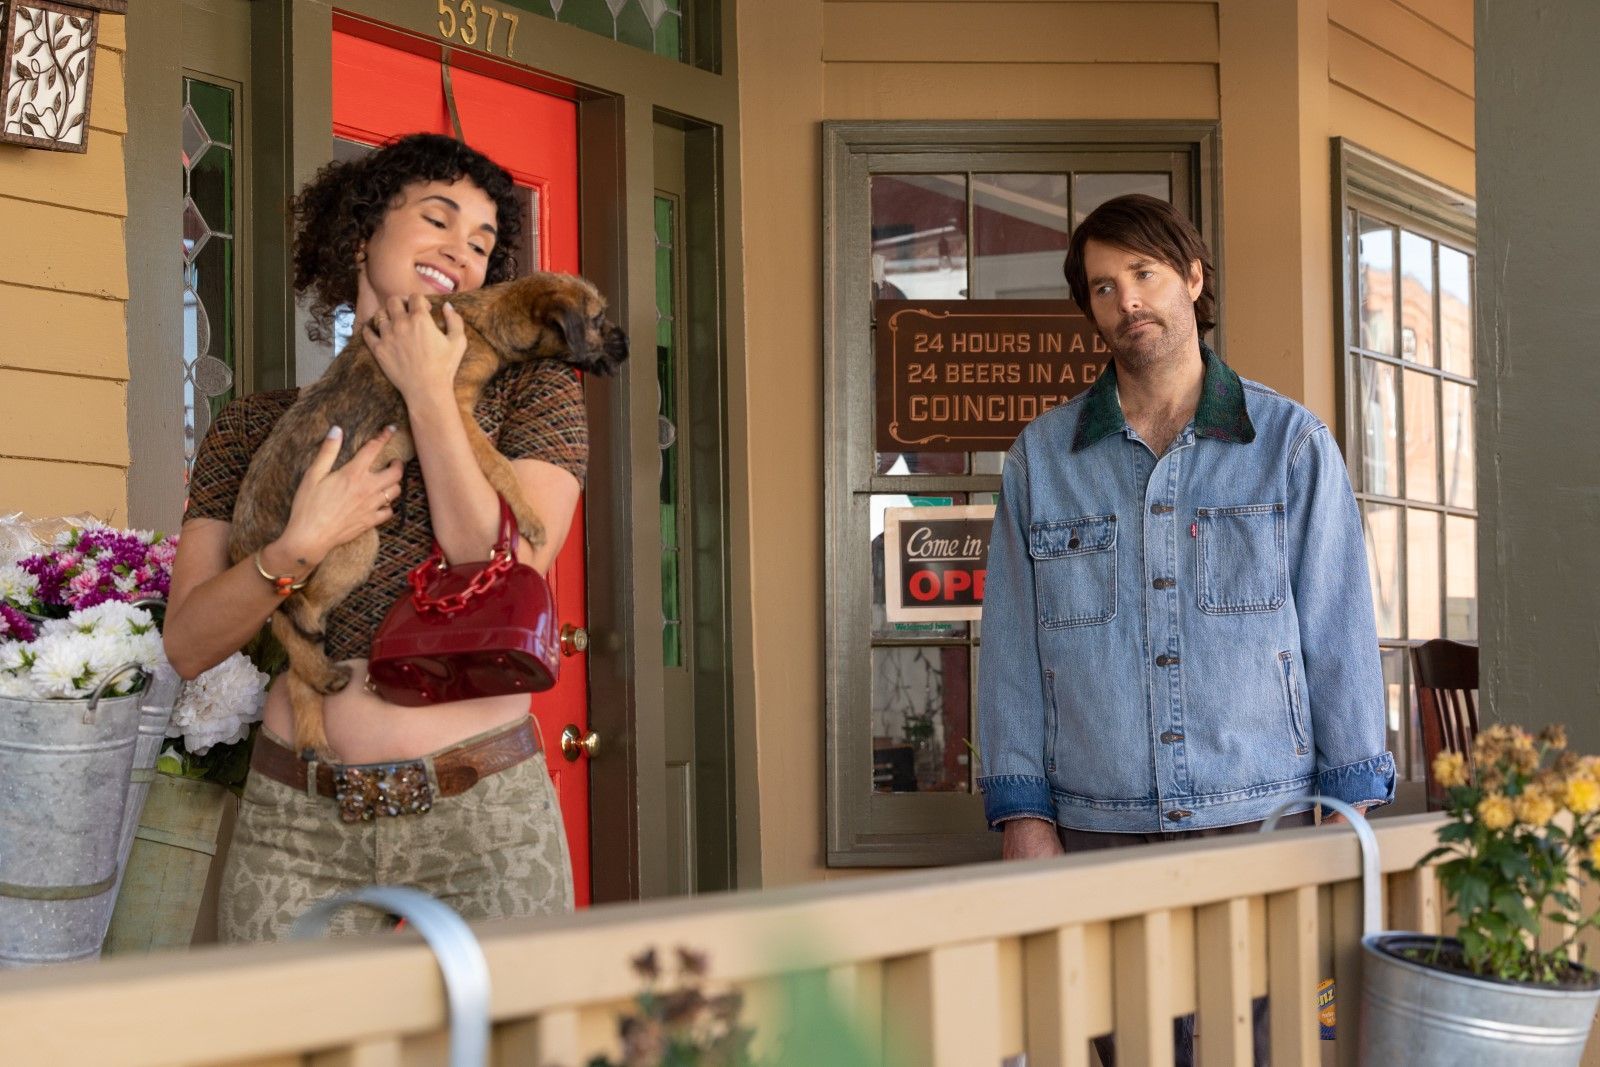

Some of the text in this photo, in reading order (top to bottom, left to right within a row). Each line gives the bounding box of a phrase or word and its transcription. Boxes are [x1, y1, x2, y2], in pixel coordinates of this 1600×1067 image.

[437, 0, 519, 58] 5377
[914, 333, 1111, 353] 24 HOURS IN A D
[907, 363, 938, 383] 24
[945, 363, 1021, 383] BEERS
[1028, 363, 1051, 383] IN
[1059, 363, 1076, 383] A
[906, 526, 982, 557] Come in
